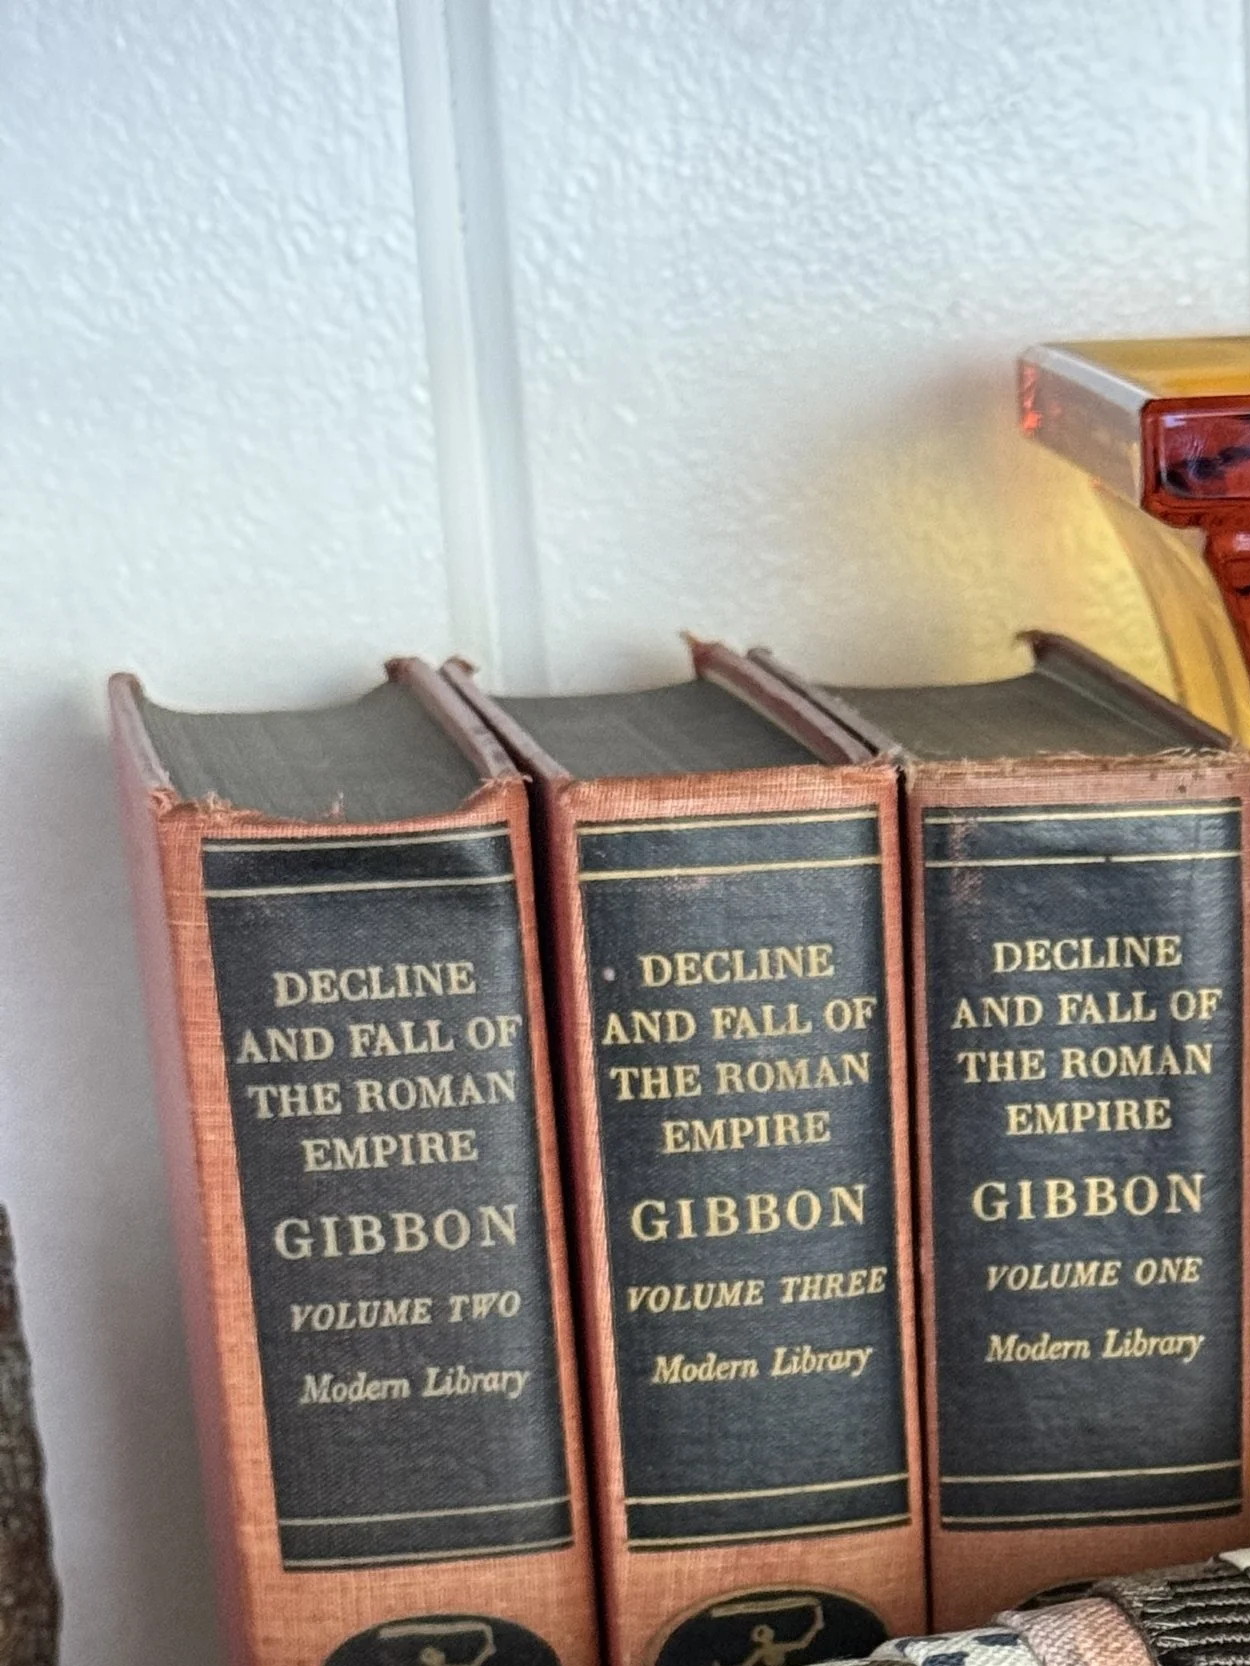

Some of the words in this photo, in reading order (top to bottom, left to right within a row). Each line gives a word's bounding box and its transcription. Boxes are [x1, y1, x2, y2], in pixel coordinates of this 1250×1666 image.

[640, 944, 834, 988] DECLINE
[993, 935, 1182, 973] DECLINE
[273, 961, 476, 1008] DECLINE
[602, 1008, 696, 1045] AND
[712, 1003, 812, 1040] FALL
[825, 997, 877, 1033] OF
[951, 996, 1042, 1030] AND
[1057, 991, 1157, 1026] FALL
[1169, 989, 1223, 1022] OF
[236, 1027, 334, 1064] AND
[348, 1019, 454, 1058] FALL
[467, 1014, 523, 1050] OF
[609, 1065, 700, 1101] THE
[716, 1051, 871, 1096] ROMAN
[957, 1048, 1046, 1084] THE
[1061, 1043, 1213, 1080] ROMAN
[248, 1080, 342, 1119] THE
[355, 1070, 516, 1113] ROMAN
[662, 1110, 831, 1155] EMPIRE
[1006, 1099, 1172, 1136] EMPIRE
[301, 1129, 478, 1172] EMPIRE
[631, 1183, 867, 1243] GIBBON
[972, 1174, 1206, 1221] GIBBON
[274, 1203, 518, 1260] GIBBON
[627, 1279, 764, 1313] VOLUME
[780, 1266, 888, 1303] THREE
[987, 1259, 1121, 1292] VOLUME
[1134, 1257, 1202, 1286] ONE
[291, 1297, 432, 1333] VOLUME
[449, 1291, 521, 1323] TWO
[652, 1352, 758, 1385] Modern
[770, 1345, 873, 1378] Library
[985, 1334, 1090, 1363] Modern
[1102, 1328, 1205, 1362] Library
[300, 1372, 409, 1405] Modern
[422, 1365, 529, 1399] Library
